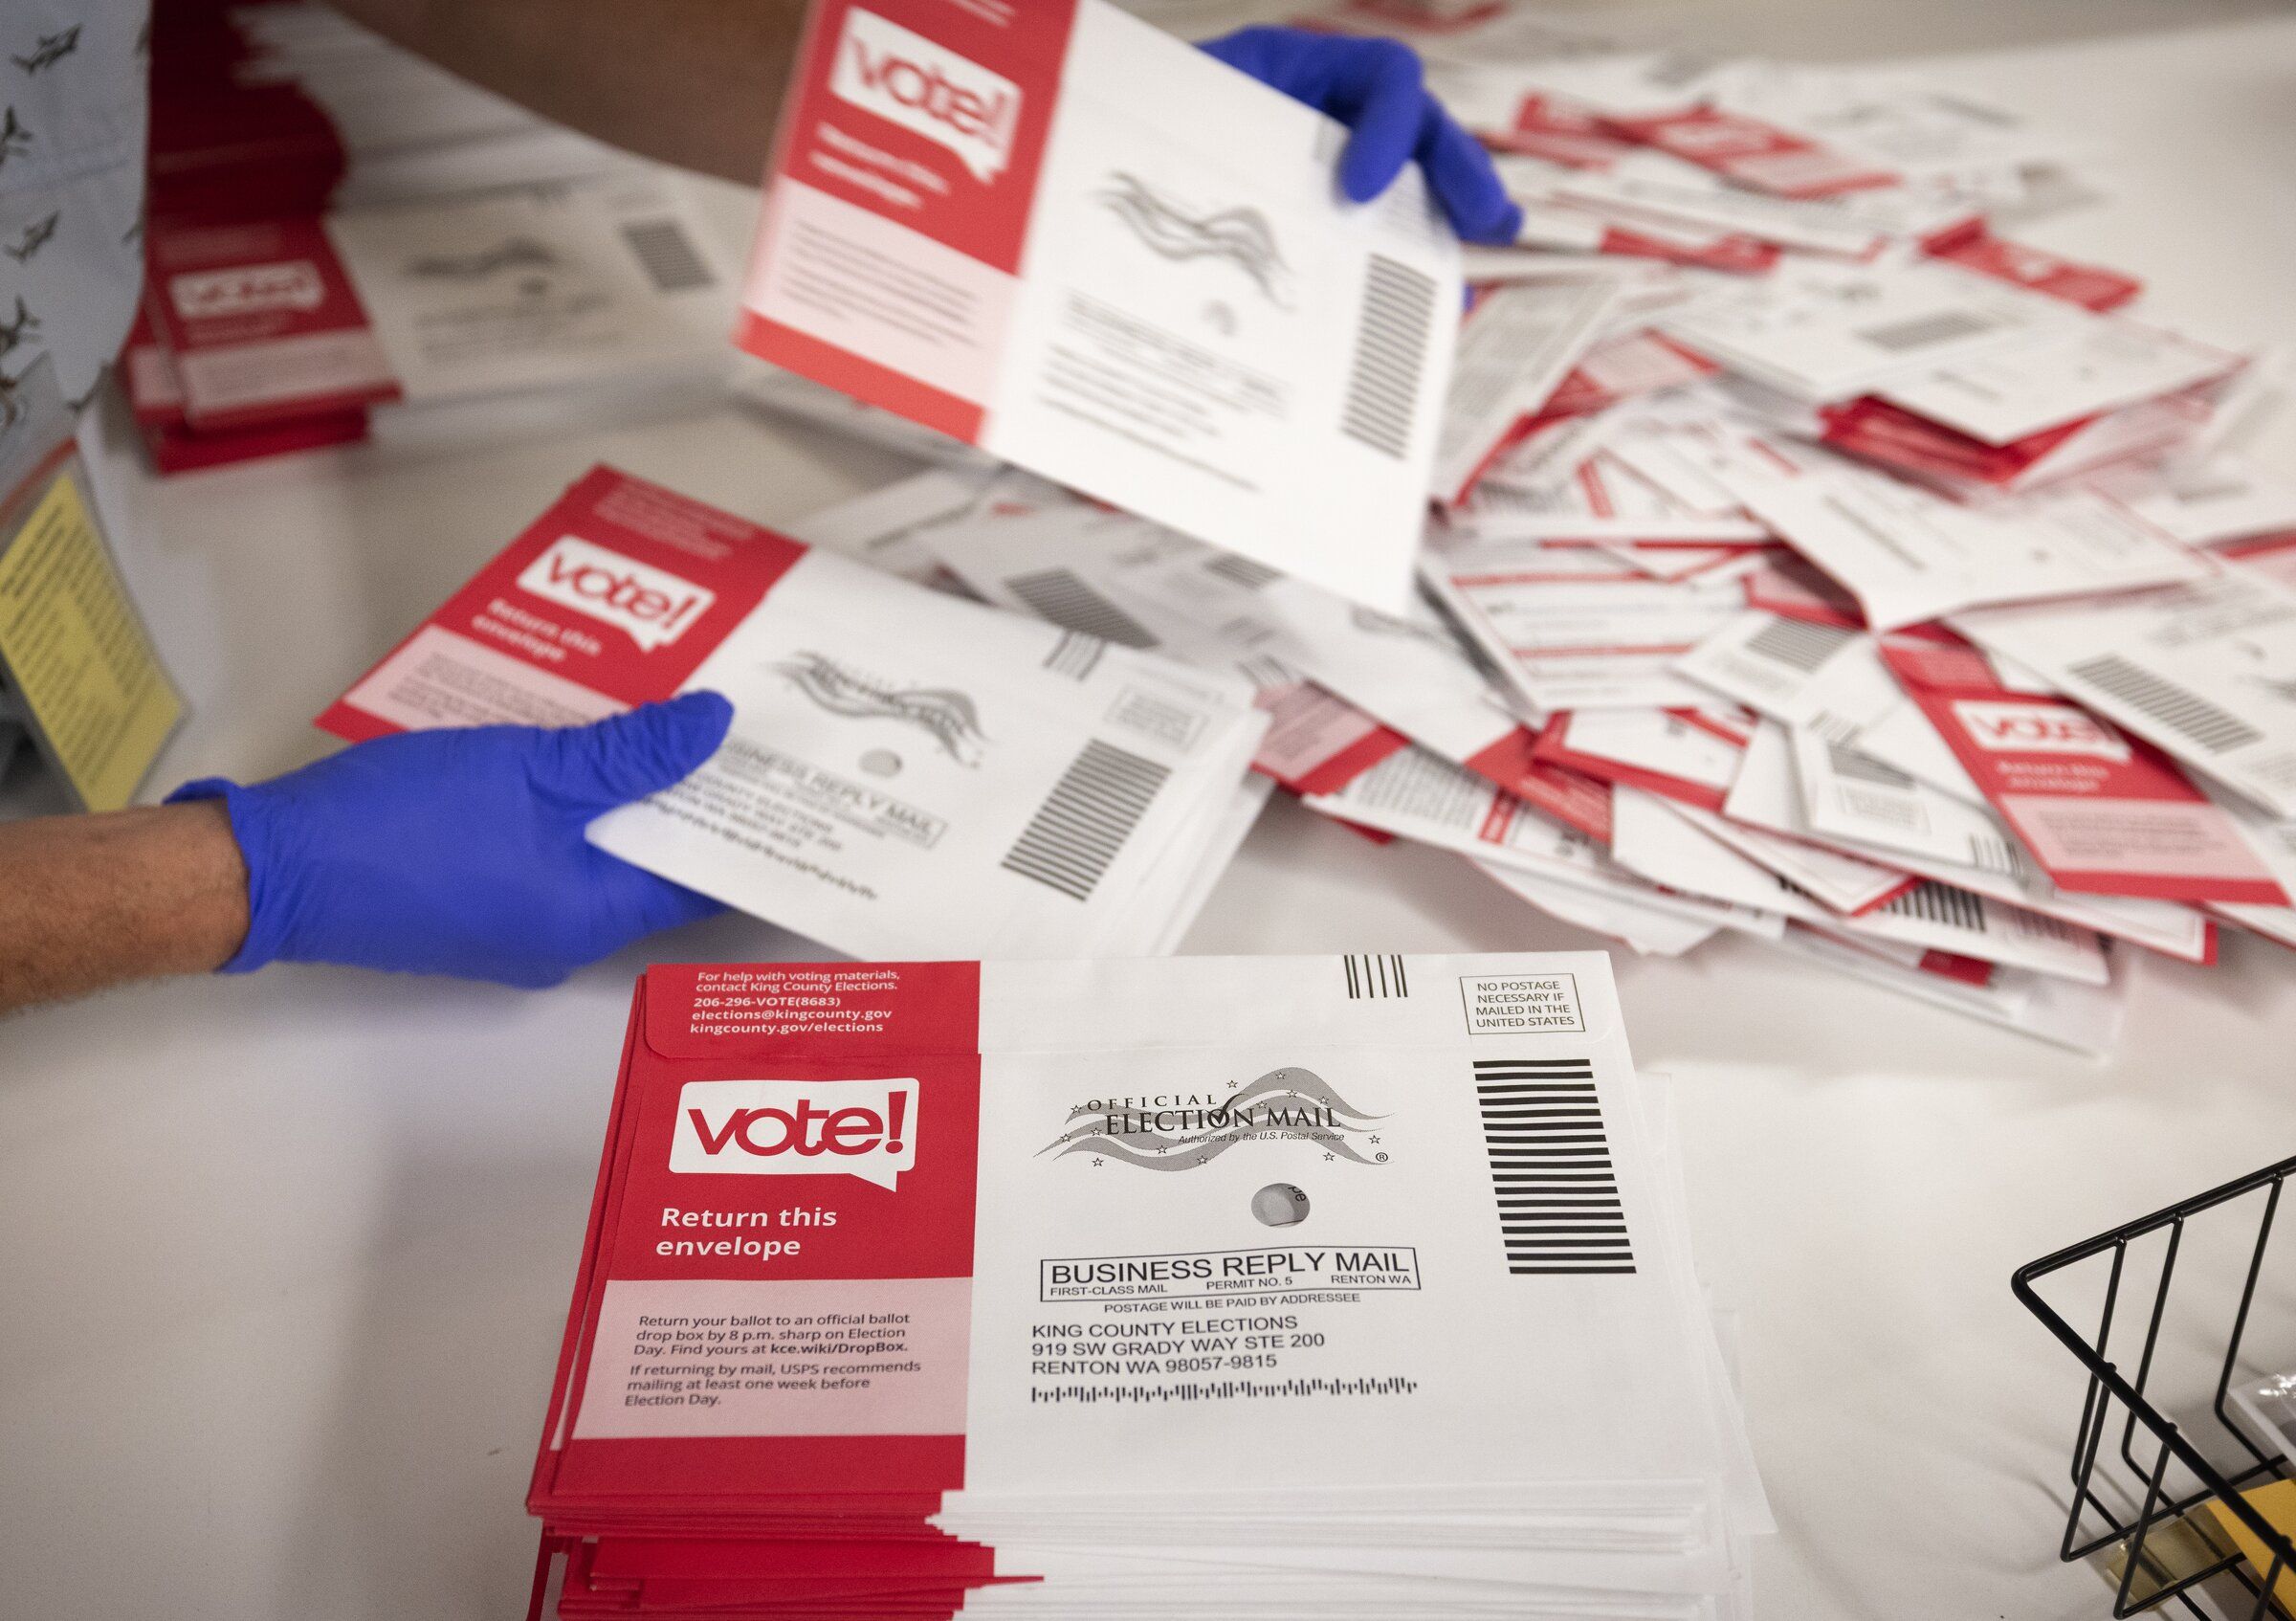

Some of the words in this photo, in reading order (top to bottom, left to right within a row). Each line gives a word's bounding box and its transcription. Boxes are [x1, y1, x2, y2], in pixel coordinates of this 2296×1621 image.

[549, 553, 697, 630] vote!
[697, 971, 719, 982] For
[723, 971, 753, 986] help
[757, 970, 785, 982] with
[789, 971, 831, 985] voting
[834, 970, 900, 982] materials,
[695, 982, 746, 992] contact
[750, 982, 779, 993] King
[784, 981, 832, 993] County
[835, 980, 897, 991] Elections.
[1477, 982, 1497, 991] NO
[1501, 981, 1560, 991] POSTAGE
[694, 997, 841, 1008] 206-296-VOTE(8683)
[1477, 992, 1550, 1003] NECESSARY
[1553, 992, 1565, 1002] IF
[692, 1009, 892, 1022] elections@kingcounty.gov
[1476, 1006, 1525, 1016] MAILED
[1528, 1005, 1544, 1015] IN
[1546, 1004, 1571, 1014] THE
[690, 1022, 884, 1035] kingcounty.gov/elections
[1476, 1017, 1525, 1028] UNITED
[1528, 1016, 1575, 1027] STATES
[1087, 1094, 1217, 1111] OFFICIAL
[687, 1090, 908, 1157] vote!
[1106, 1107, 1254, 1136] ELECTION
[1267, 1106, 1341, 1129] MAIL
[1178, 1133, 1226, 1144] Authorized
[1229, 1133, 1242, 1144] by
[1243, 1132, 1258, 1142] the
[1259, 1131, 1278, 1141] U.S.
[1280, 1131, 1310, 1141] Postal
[1311, 1131, 1345, 1142] Service
[661, 1208, 768, 1228] Return
[779, 1207, 837, 1227] this
[655, 1236, 801, 1261] envelope
[1051, 1259, 1213, 1284] BUSINESS
[1223, 1252, 1327, 1277] REPLY
[1336, 1252, 1410, 1272] MAIL
[1206, 1278, 1256, 1291] PERMIT
[1258, 1277, 1283, 1288] NO.
[1285, 1277, 1293, 1286] 5
[1331, 1275, 1384, 1285] RENTON
[1387, 1275, 1412, 1284] WA
[1050, 1285, 1136, 1297] FIRST-CLASS
[1137, 1284, 1168, 1295] MAIL
[1104, 1301, 1168, 1314] POSTAGE
[1170, 1299, 1201, 1311] WILL
[1203, 1298, 1224, 1310] BE
[1225, 1297, 1257, 1308] PAID
[1260, 1296, 1278, 1307] BY
[1279, 1293, 1361, 1305] ADDRESSEE
[639, 1316, 689, 1327] Return
[693, 1318, 727, 1329] your
[730, 1315, 772, 1326] ballot
[776, 1316, 790, 1326] to
[794, 1317, 813, 1326] an
[816, 1314, 865, 1325] official
[869, 1313, 910, 1324] ballot
[1031, 1323, 1083, 1339] KING
[1089, 1321, 1176, 1338] COUNTY
[1181, 1315, 1298, 1335] ELECTIONS
[636, 1330, 673, 1343] drop
[676, 1330, 704, 1341] box
[708, 1330, 726, 1343] by
[729, 1330, 740, 1341] 8
[741, 1331, 775, 1343] p.m.
[779, 1329, 822, 1342] sharp
[825, 1329, 844, 1340] on
[849, 1328, 906, 1340] Election
[633, 1343, 667, 1358] Day.
[671, 1343, 703, 1355] Find
[706, 1344, 748, 1357] yours
[751, 1344, 766, 1354] at
[770, 1342, 908, 1356] kce.wiki/DropBox.
[1031, 1342, 1067, 1357] 919
[1073, 1342, 1106, 1356] SW
[1112, 1340, 1185, 1356] GRADY
[1191, 1338, 1240, 1354] WAY
[1245, 1334, 1286, 1350] STE
[1291, 1333, 1325, 1348] 200
[629, 1364, 642, 1376] If
[644, 1365, 716, 1378] returning
[718, 1365, 738, 1377] by
[740, 1364, 776, 1376] mail,
[781, 1364, 820, 1375] USPS
[823, 1361, 921, 1375] recommends
[1031, 1360, 1120, 1376] RENTON
[1125, 1359, 1160, 1374] WA
[1165, 1354, 1277, 1373] 98057-9815
[627, 1379, 683, 1393] mailing
[686, 1379, 702, 1390] at
[705, 1379, 741, 1390] least
[744, 1380, 774, 1389] one
[777, 1379, 817, 1390] week
[821, 1378, 871, 1389] before
[625, 1394, 686, 1407] Election
[689, 1394, 721, 1408] Day.
